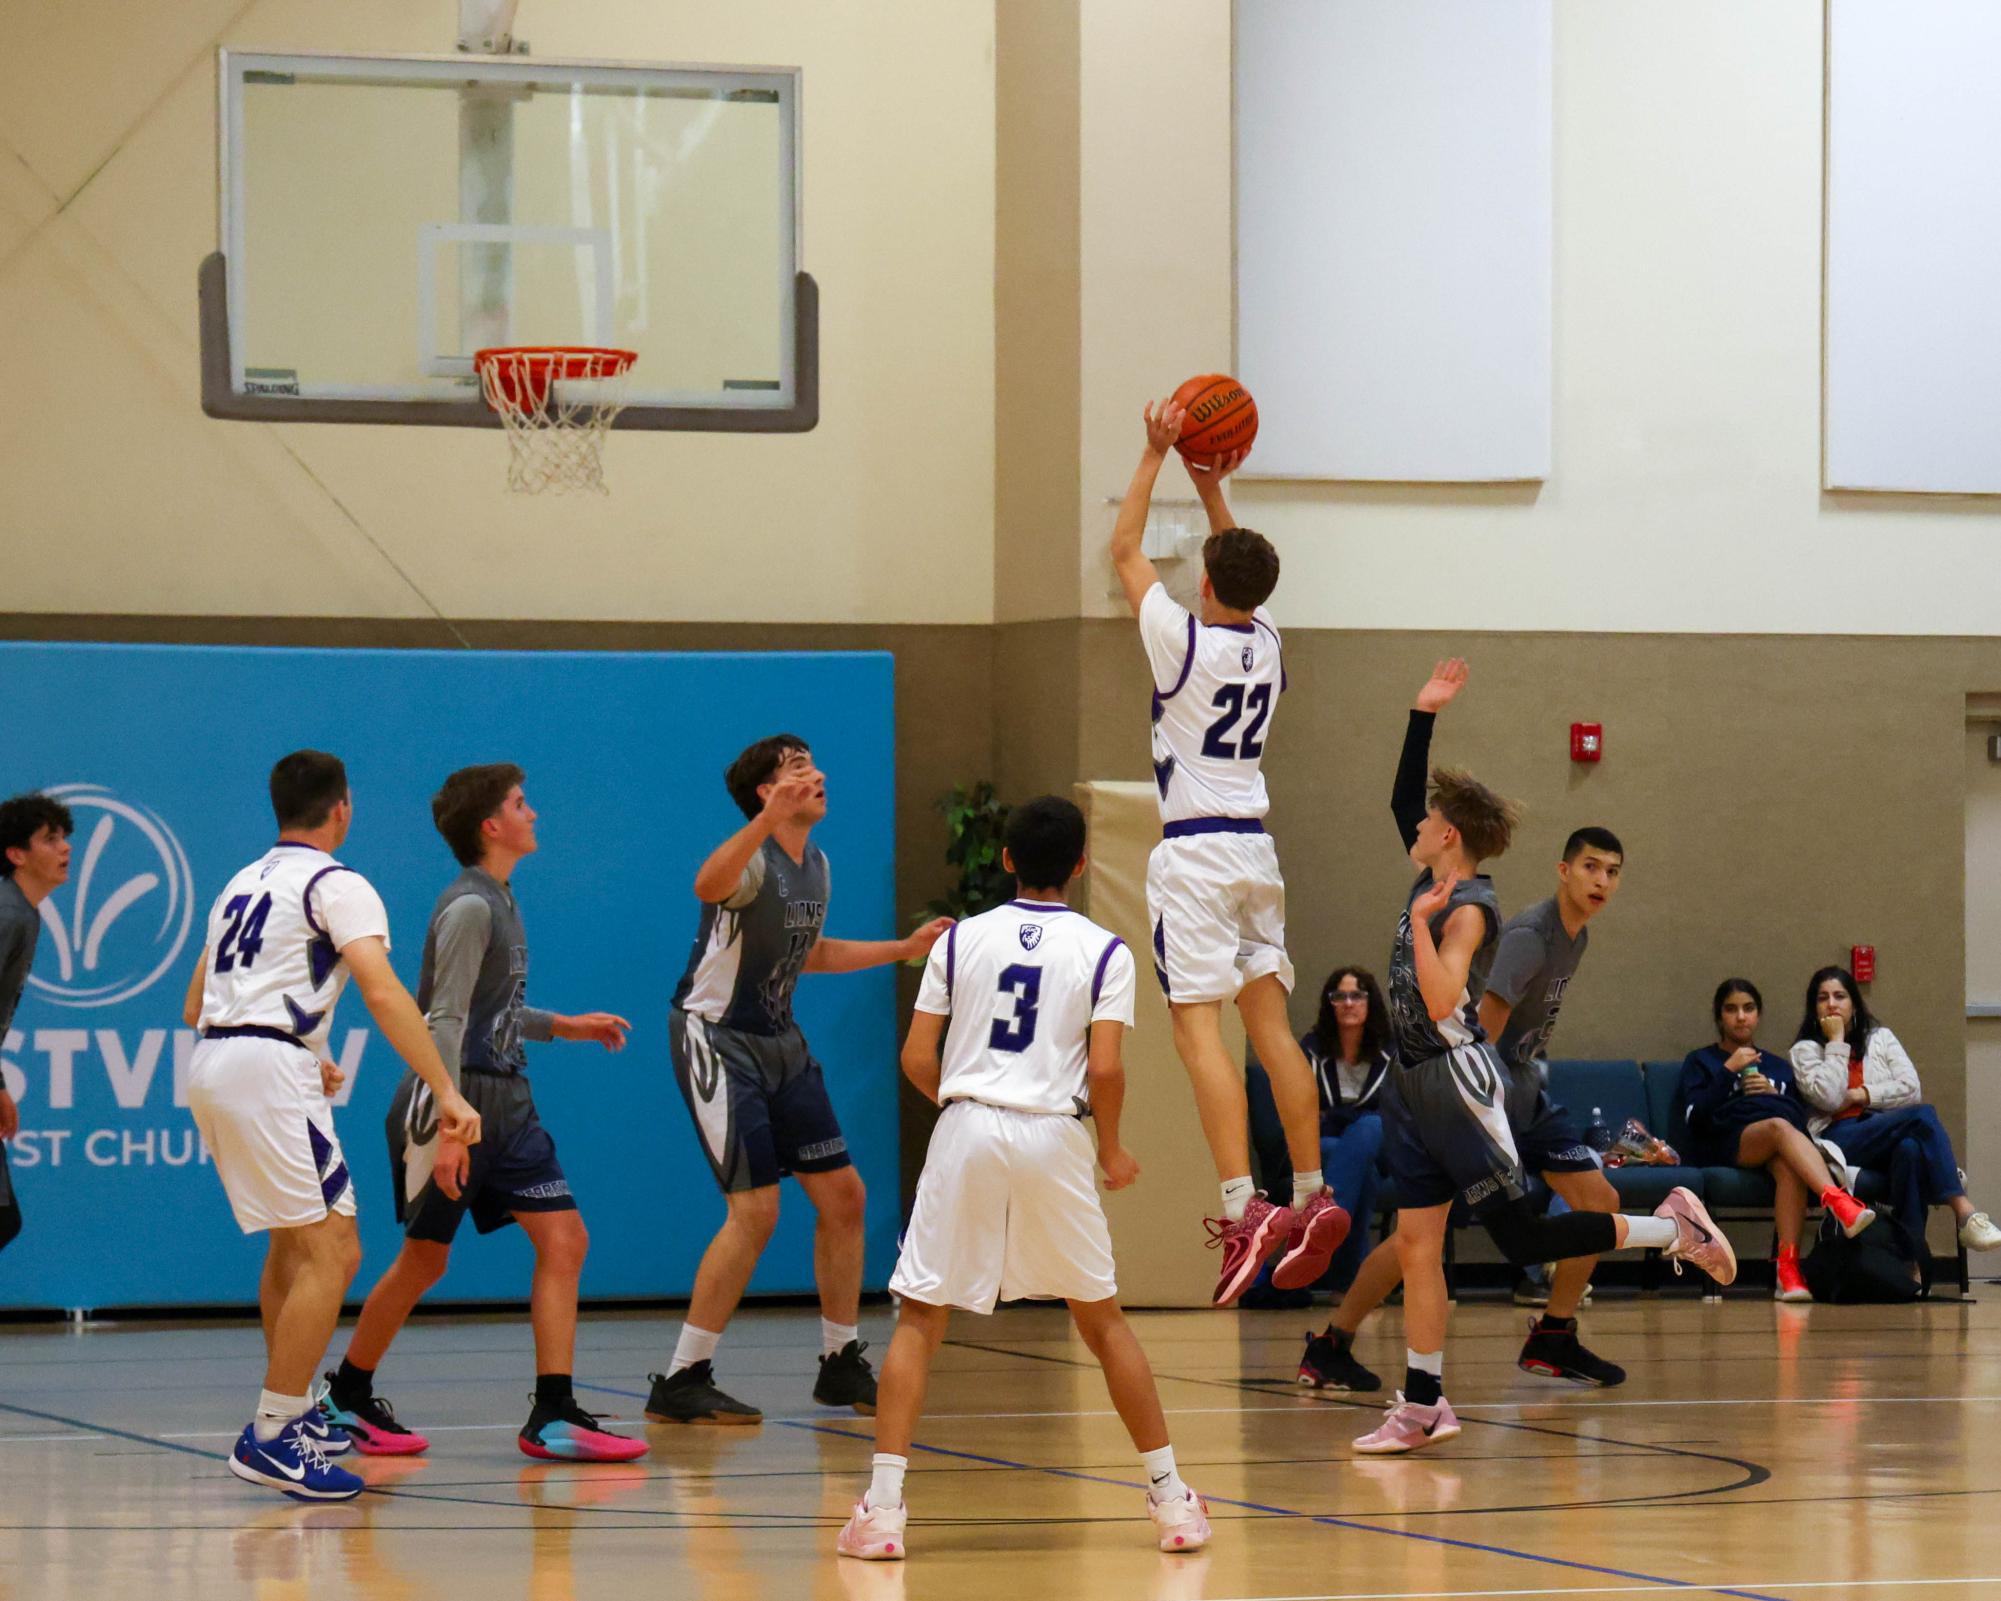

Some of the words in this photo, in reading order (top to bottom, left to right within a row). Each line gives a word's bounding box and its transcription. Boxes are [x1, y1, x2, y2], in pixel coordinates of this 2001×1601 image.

[1200, 682, 1272, 760] 22
[214, 890, 273, 974] 24
[987, 962, 1043, 1053] 3
[4, 1130, 71, 1167] ST
[84, 1129, 209, 1166] CHU
